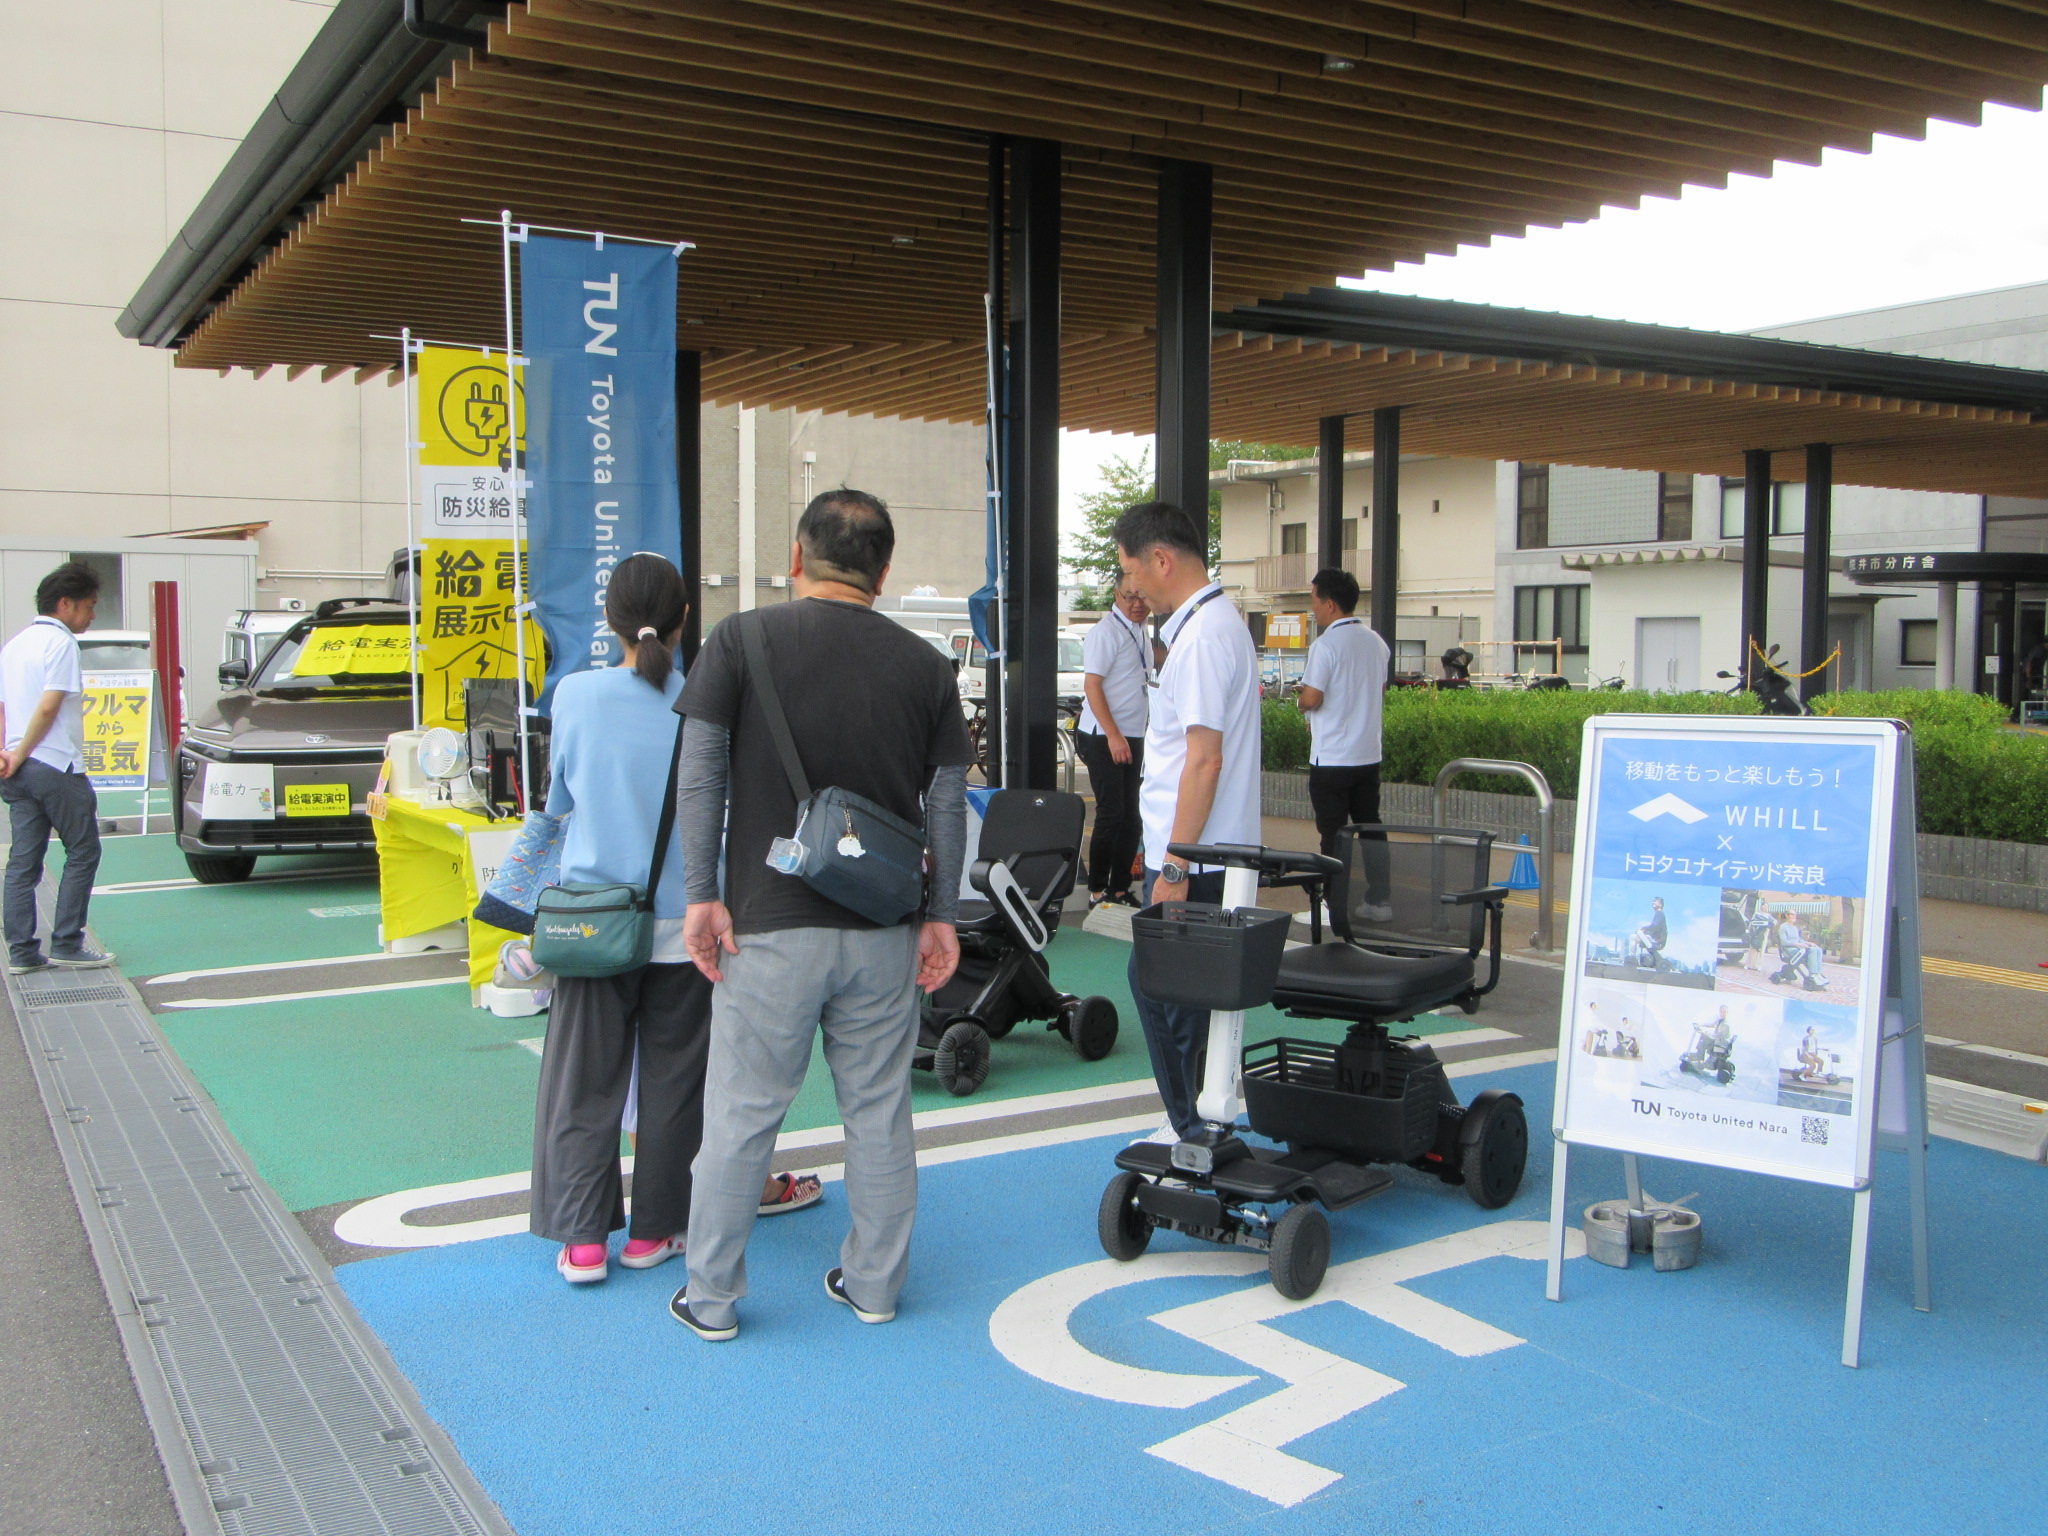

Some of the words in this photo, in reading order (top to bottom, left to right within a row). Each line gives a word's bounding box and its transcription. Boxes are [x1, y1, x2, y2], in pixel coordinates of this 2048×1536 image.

[583, 273, 618, 357] TUN
[587, 374, 615, 484] Toyota
[473, 476, 504, 491] 安心
[591, 621, 616, 670] Nar
[82, 693, 147, 717] クルマ
[96, 721, 124, 735] から
[82, 740, 140, 772] 電気
[1625, 760, 1841, 788] 移動をもっと楽しもう！
[210, 782, 261, 796] 給電カー
[289, 793, 346, 805] 給電実演中
[1725, 805, 1828, 832] WHILL
[1625, 852, 1826, 886] トヨタユナイテッド奈良
[1631, 1098, 1661, 1117] TUN
[1667, 1106, 1707, 1122] Toyota
[1713, 1114, 1754, 1129] United
[1759, 1120, 1788, 1134] Nara
